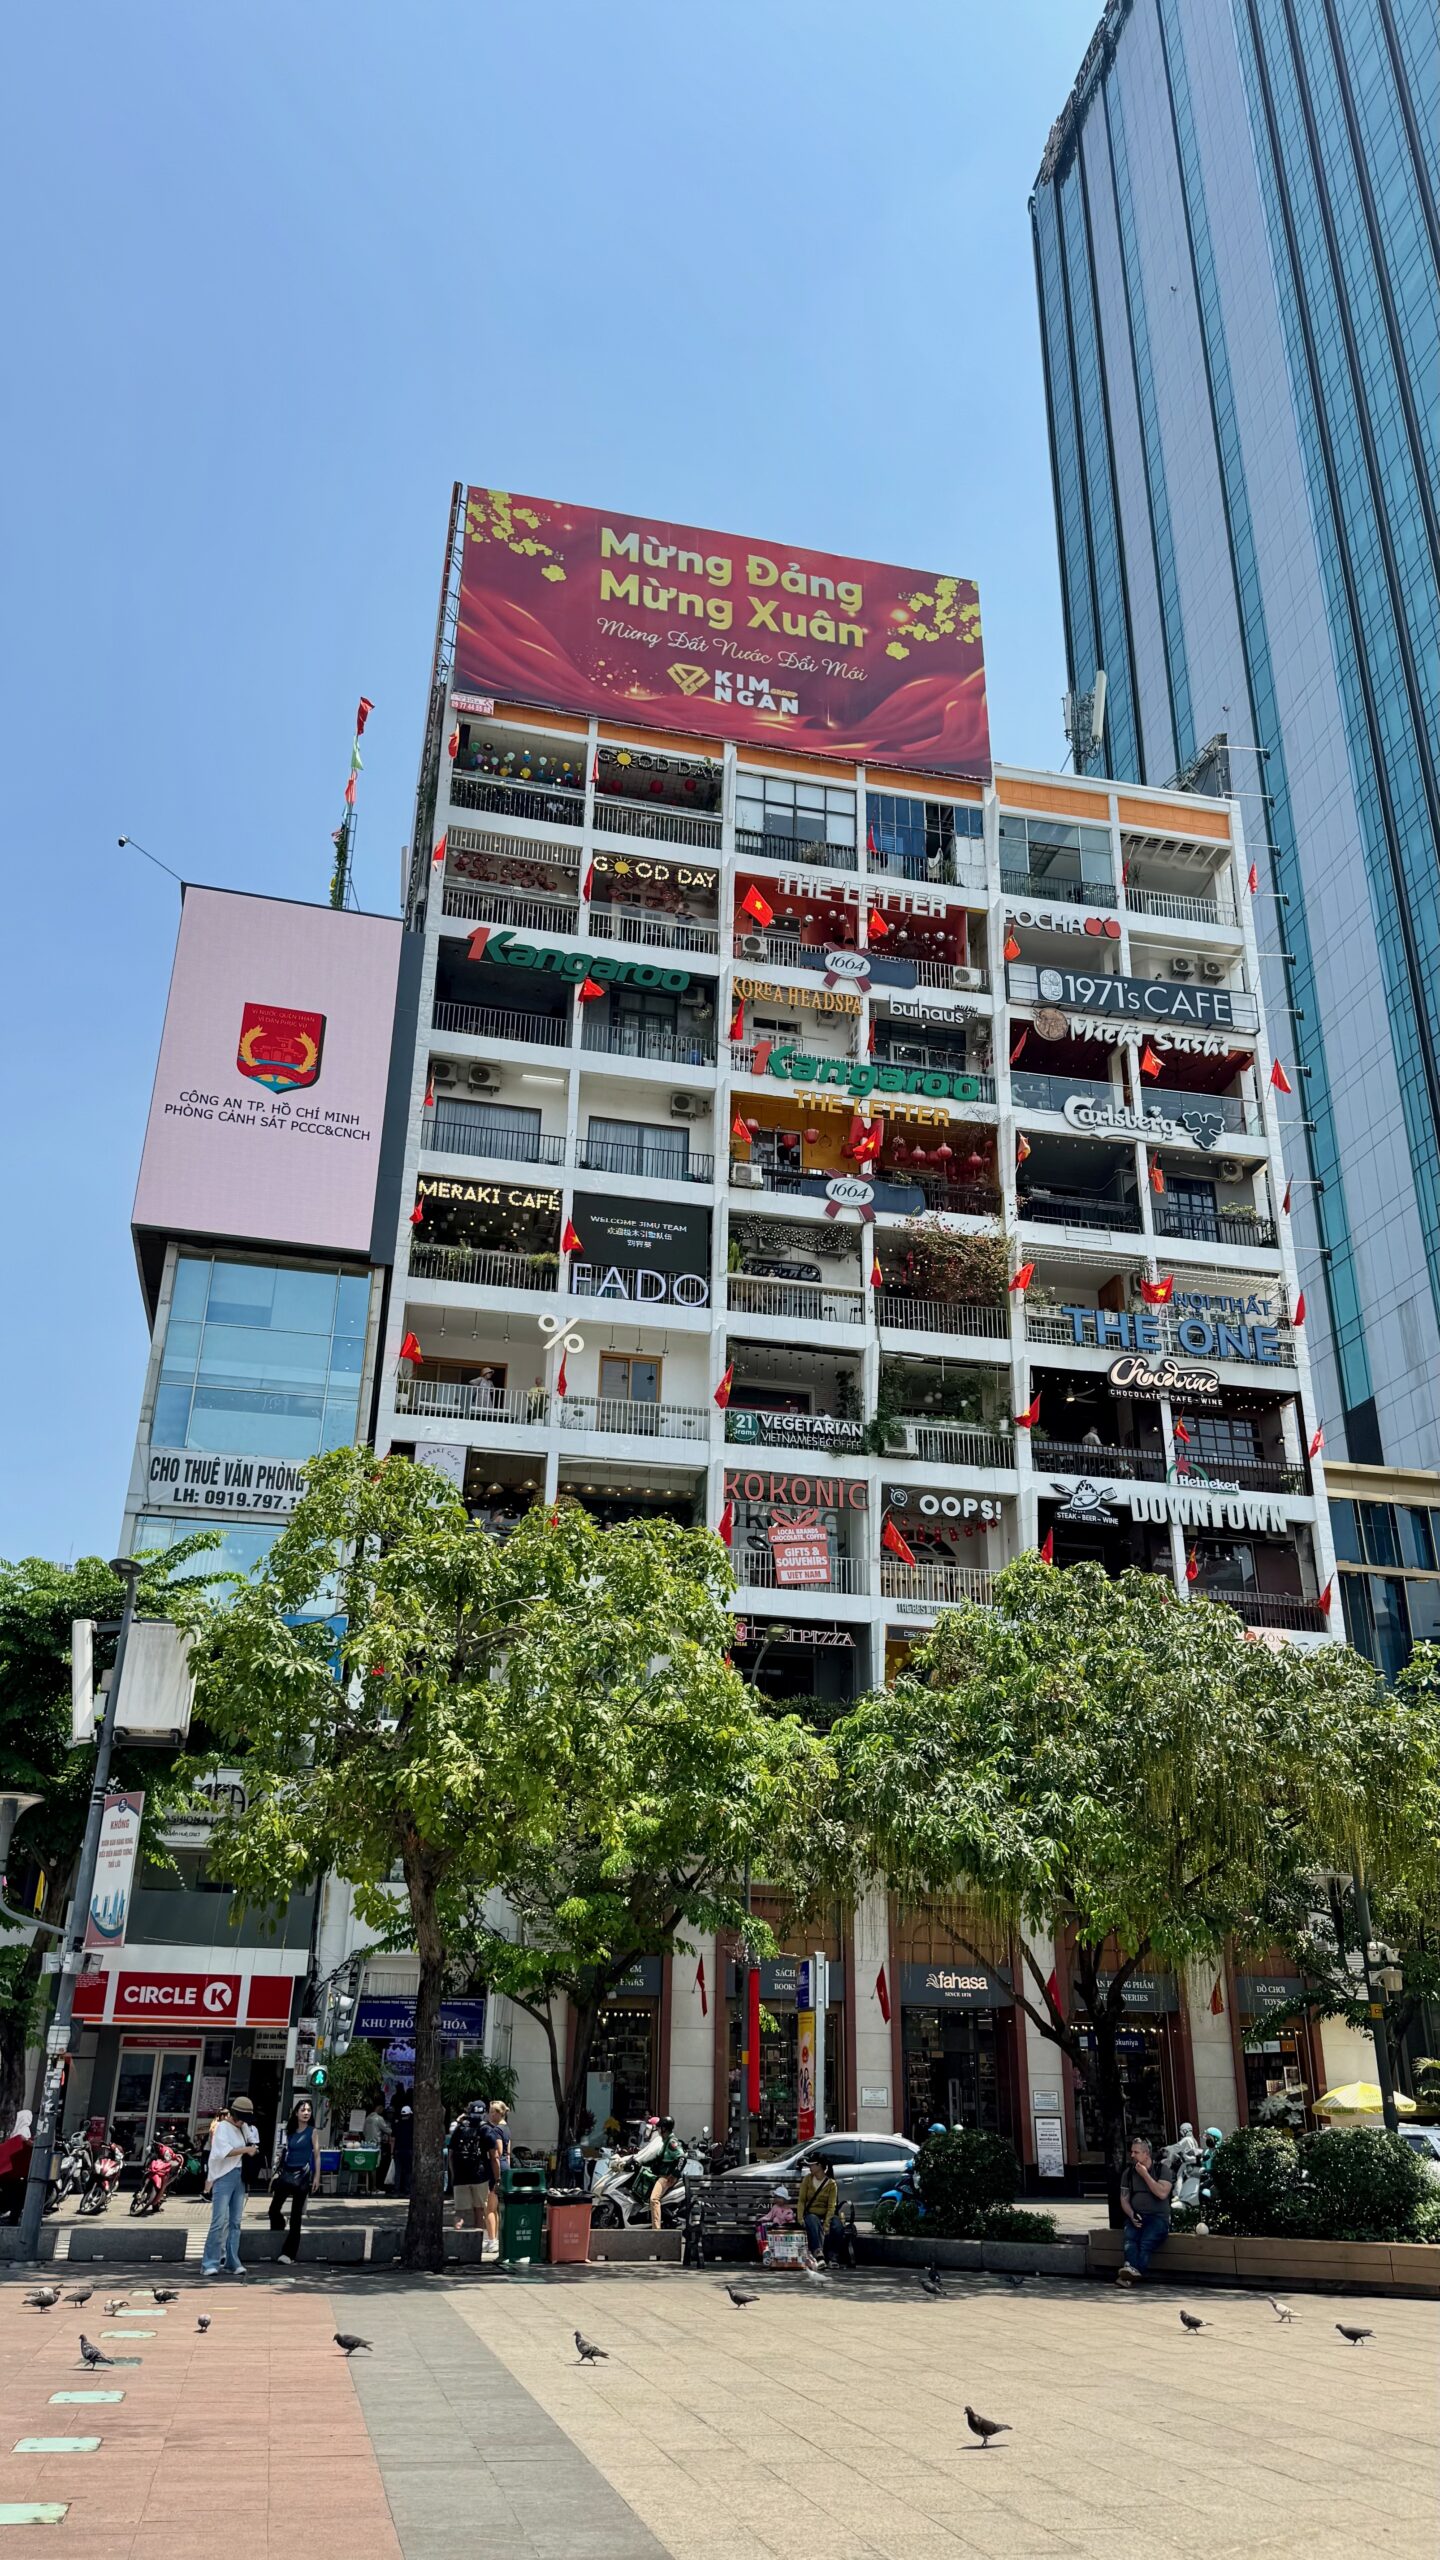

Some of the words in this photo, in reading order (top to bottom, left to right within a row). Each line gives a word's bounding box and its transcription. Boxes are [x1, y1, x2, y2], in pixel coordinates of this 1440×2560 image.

[600, 528, 732, 588] Mừng
[746, 554, 863, 611] Đảng
[600, 569, 733, 630] Mừng
[747, 594, 865, 648] Xuân
[597, 617, 662, 648] Mừng
[668, 630, 709, 652] Đất
[713, 638, 772, 664] Nước
[778, 650, 818, 673] Đổi
[822, 658, 868, 681] Mới
[715, 670, 770, 693] KIM
[678, 869, 717, 888] DAY
[778, 871, 832, 900] THE
[844, 880, 946, 918] LETTER
[1004, 908, 1085, 935] POCHA
[830, 956, 866, 972] 1664
[732, 976, 784, 1003] KOREA
[788, 987, 863, 1015] HEADSPA
[1065, 974, 1140, 1010] 1971's
[1144, 986, 1231, 1023] CAFE
[179, 1089, 220, 1107] CÔNG
[223, 1096, 243, 1110] AN
[247, 1100, 266, 1113] TP.
[271, 1101, 292, 1117] HỒ
[296, 1105, 320, 1120] CHÍ
[325, 1111, 360, 1126] MINH
[794, 1089, 844, 1114] THE
[853, 1096, 950, 1127] LETTER
[1064, 1095, 1178, 1139] Carlsberg
[164, 1103, 214, 1121] PHÒNG
[218, 1108, 256, 1125] CẢNH
[260, 1113, 287, 1130] SÁT
[290, 1121, 371, 1142] PCCC&CNCH
[418, 1179, 500, 1206] MERAKI
[508, 1189, 561, 1212] CAFÉ
[831, 1182, 870, 1199] 1664
[1173, 1289, 1211, 1312] NỘI
[1217, 1293, 1272, 1316] THẤT
[1061, 1306, 1162, 1352] THE
[1178, 1318, 1281, 1362] ONE
[1110, 1389, 1161, 1400] CHOCOLATE
[1170, 1395, 1192, 1403] CAFE
[1201, 1398, 1223, 1406] WINE
[736, 1414, 752, 1429] 21
[761, 1414, 863, 1437] VEGETARIAN
[150, 1456, 180, 1483] CHO
[185, 1456, 219, 1486] THUÊ
[224, 1458, 253, 1488] VĂN
[1178, 1474, 1240, 1491] Heineken
[173, 1488, 199, 1504] LH:
[204, 1490, 299, 1510] 0919.797.1
[919, 1494, 1002, 1520] OOPS!
[1056, 1511, 1077, 1520] STEAK
[1082, 1514, 1097, 1522] BEER
[1102, 1516, 1119, 1525] WINE
[1130, 1493, 1288, 1533] DOWNTOWN
[776, 1556, 828, 1567] SOUVENIRS
[784, 1547, 810, 1557] GIFTS
[812, 1546, 819, 1556] &
[939, 1971, 988, 1990] fahasa
[124, 1985, 197, 2004] CIRCLE
[362, 2019, 386, 2028] KHU
[442, 2018, 468, 2029] HÓA
